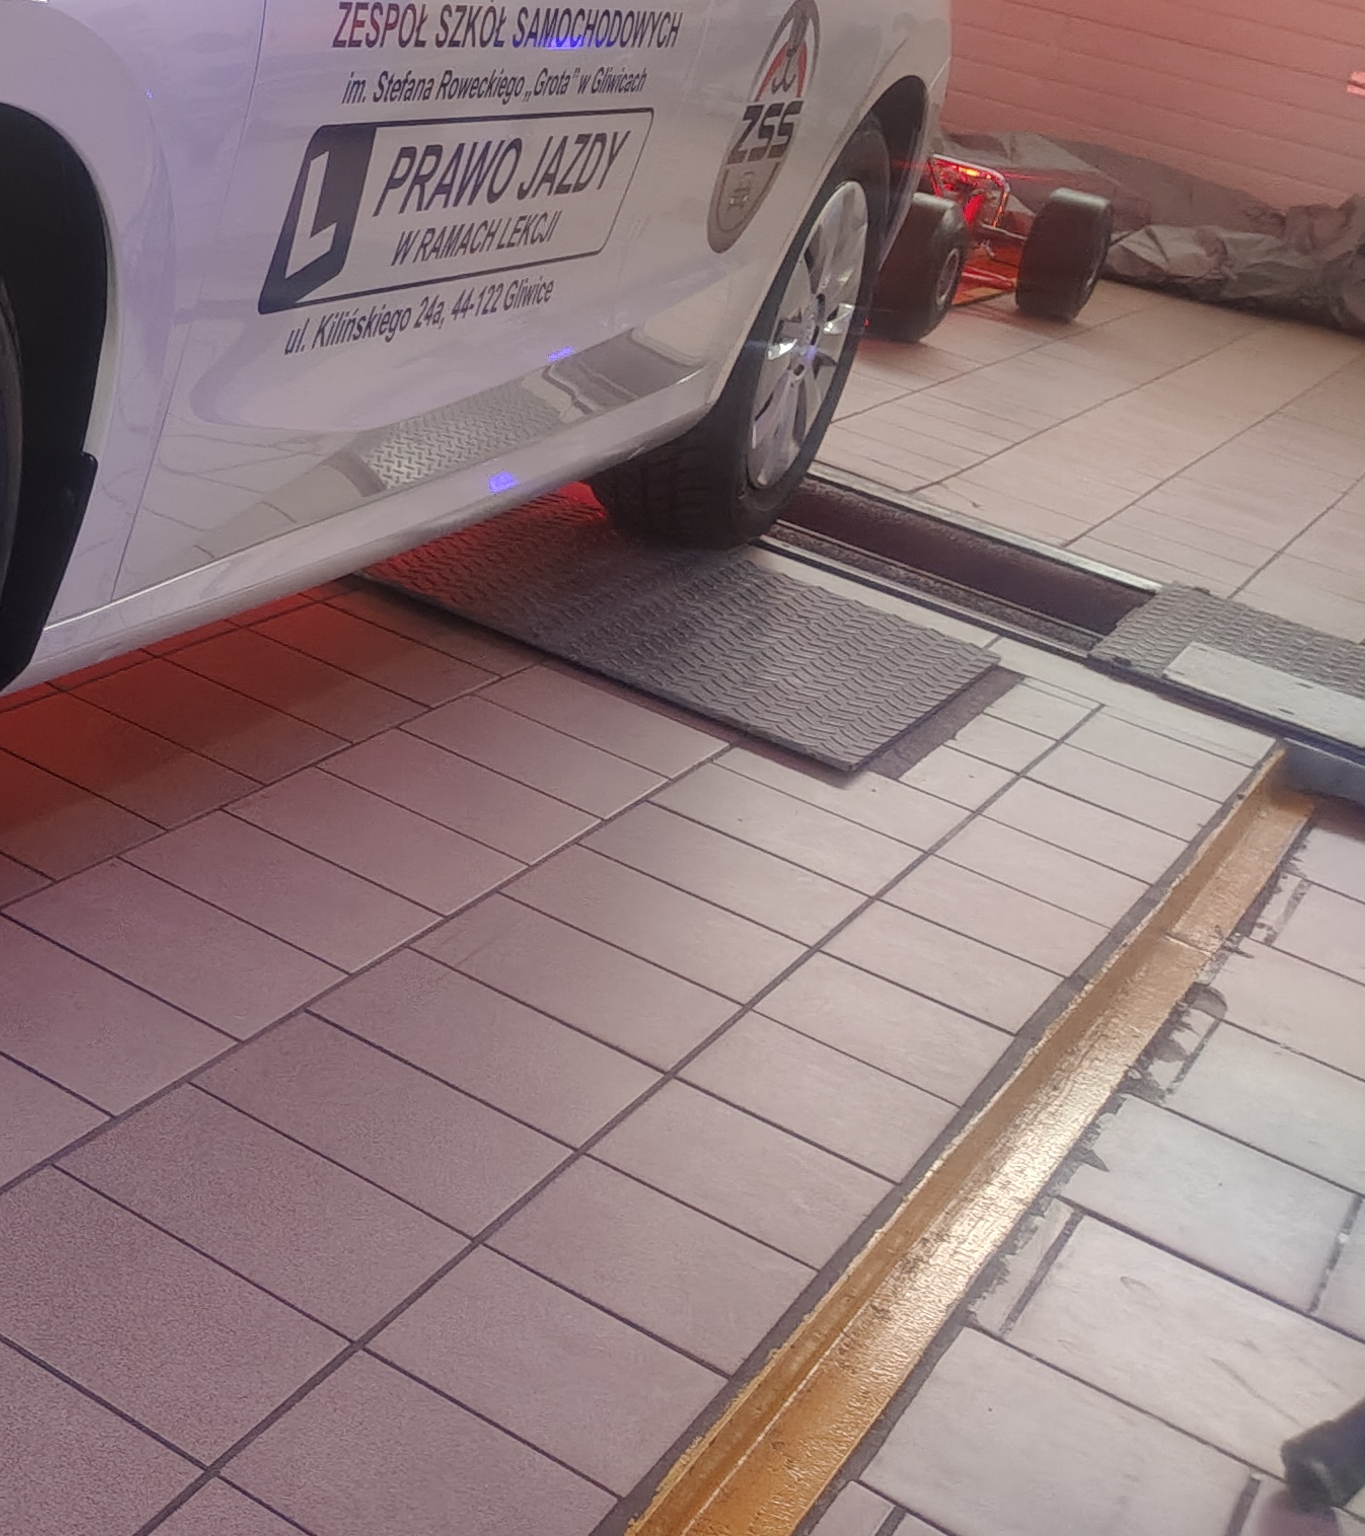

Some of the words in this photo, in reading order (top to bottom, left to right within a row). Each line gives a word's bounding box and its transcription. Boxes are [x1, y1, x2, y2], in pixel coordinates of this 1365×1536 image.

[512, 6, 683, 49] SAMOCHODOWYCH
[342, 71, 367, 104] im.
[373, 71, 435, 103] Stefana
[435, 68, 523, 105] Roweckiego
[577, 74, 590, 94] w
[591, 67, 648, 94] Gliwicach
[727, 100, 804, 165] ZSS
[372, 138, 522, 217] PRAWO
[519, 131, 631, 201] JAZDY
[285, 150, 338, 279] L
[391, 229, 416, 266] W
[417, 221, 501, 261] RAMACH
[497, 211, 563, 251] LEKCJI
[284, 318, 310, 355] ul.
[311, 303, 413, 350] Kilińskiego
[414, 296, 446, 330] 24a,
[450, 284, 501, 320] 44-122
[502, 275, 555, 311] Gliwice
